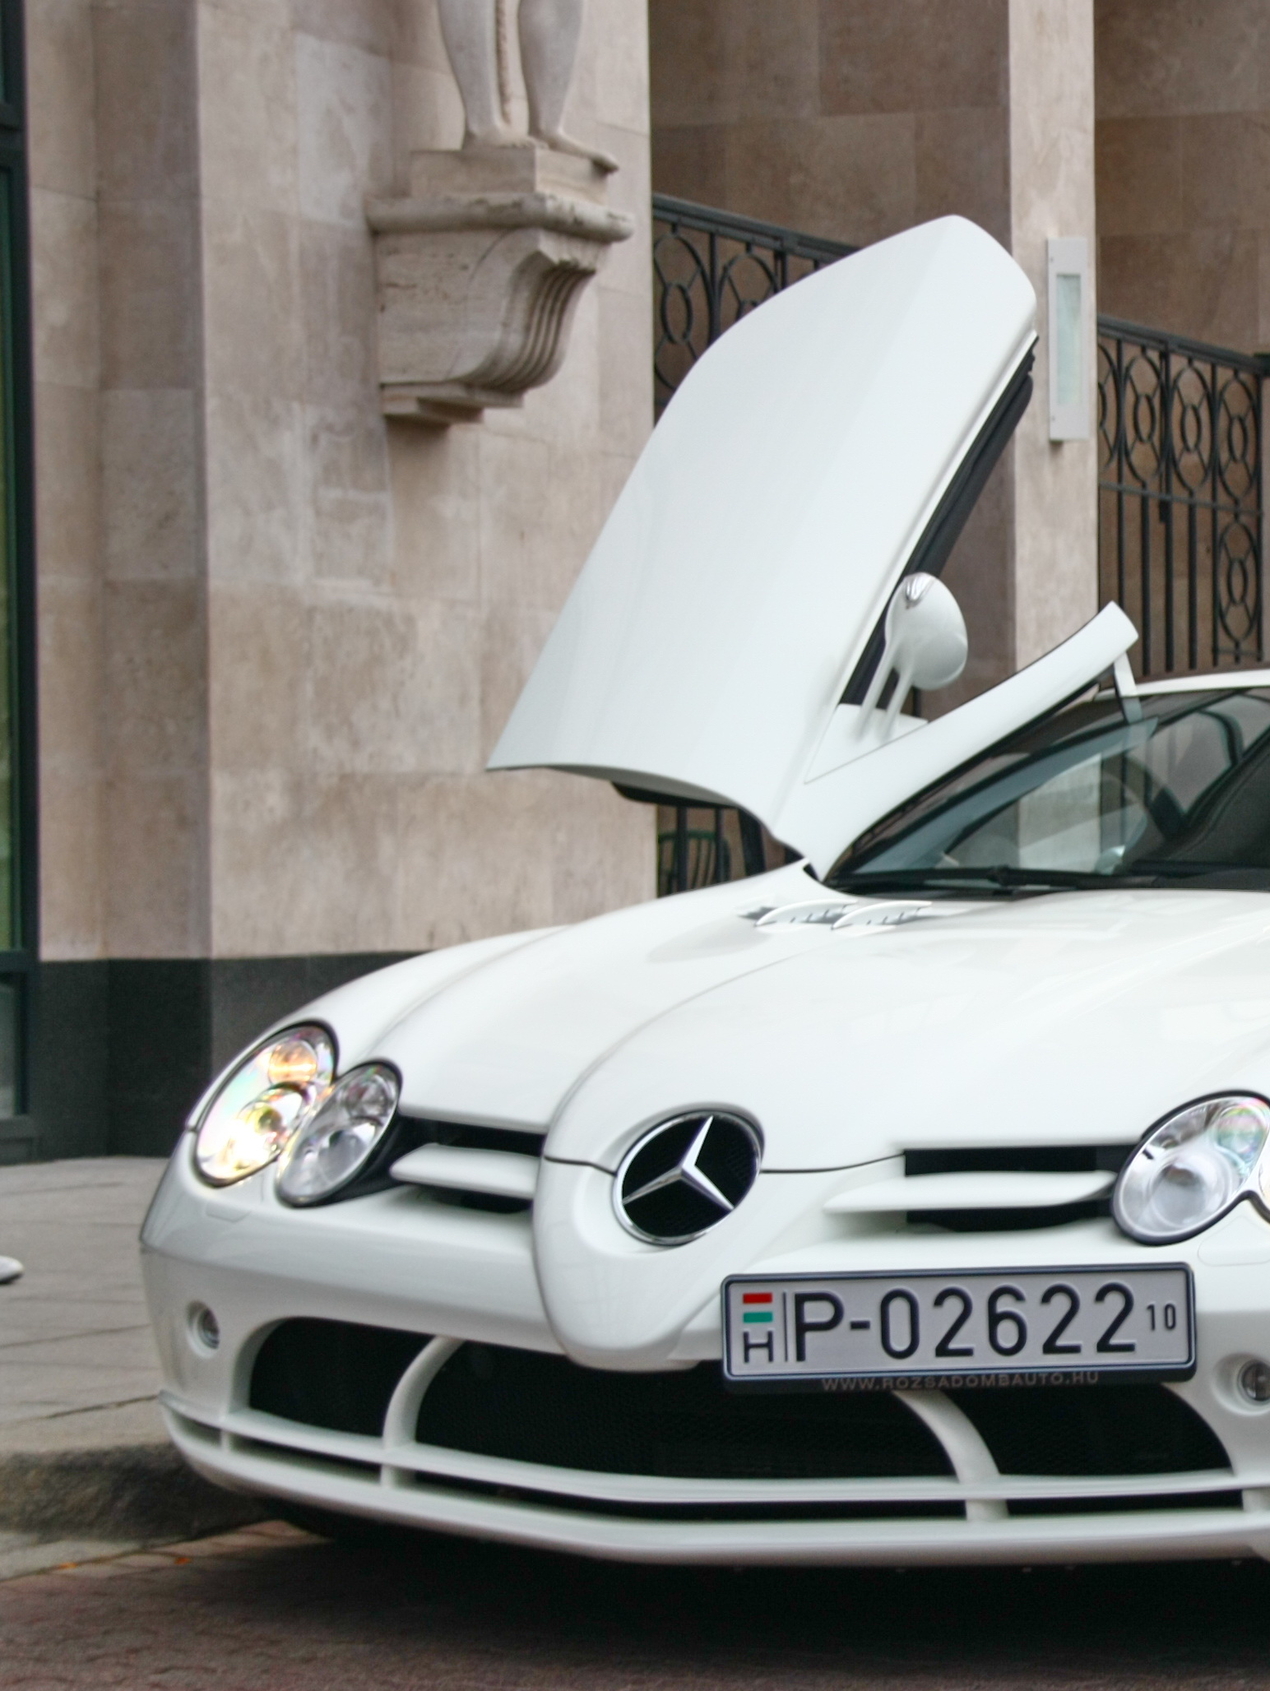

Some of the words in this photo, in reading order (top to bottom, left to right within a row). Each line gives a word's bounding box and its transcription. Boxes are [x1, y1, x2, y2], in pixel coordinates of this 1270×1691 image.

[743, 1331, 773, 1362] H
[794, 1281, 1136, 1362] P-02622
[1147, 1303, 1176, 1331] 10
